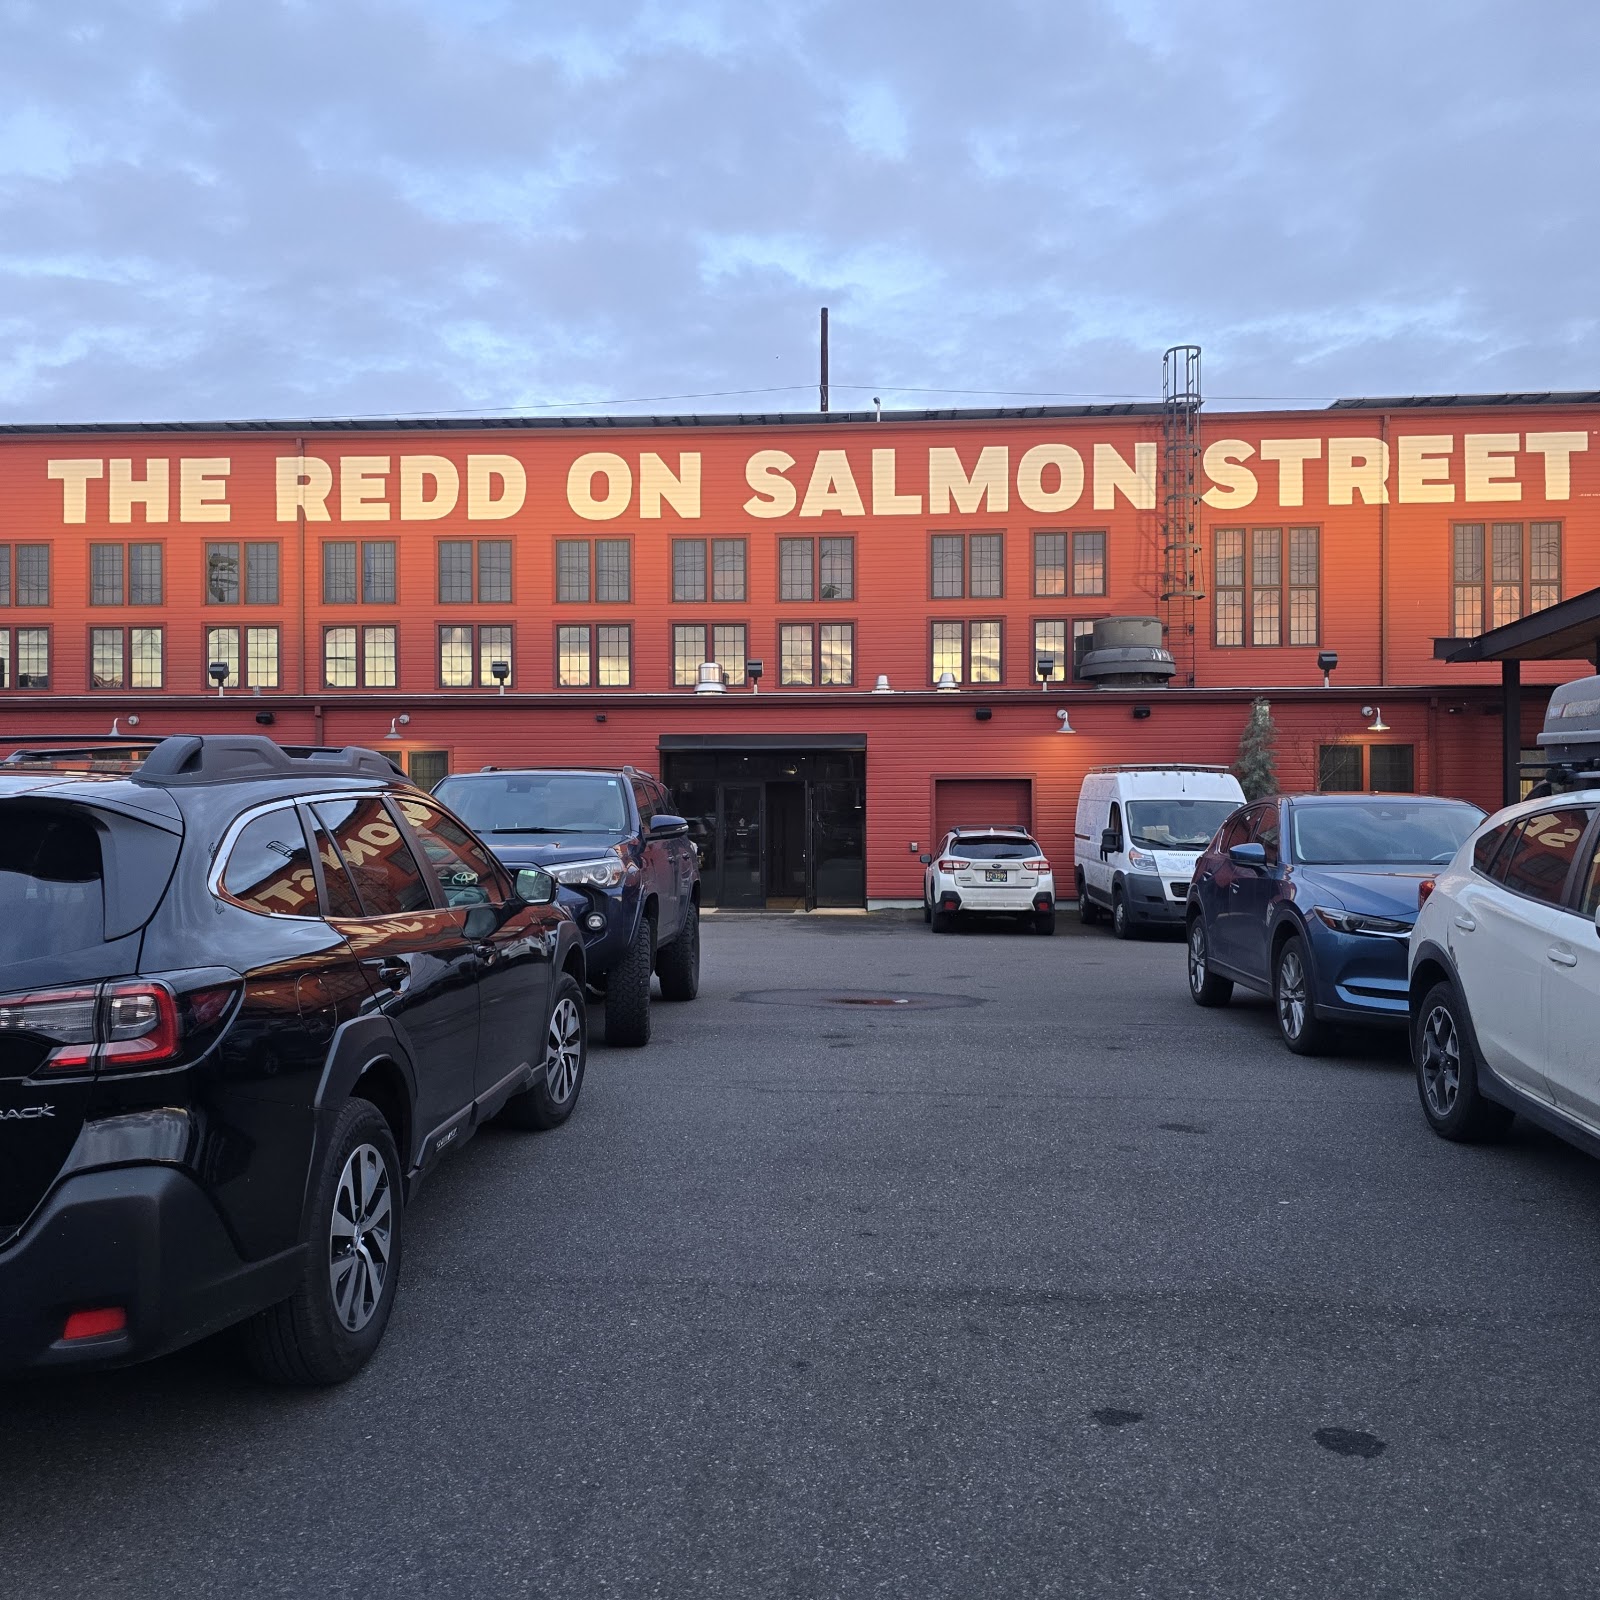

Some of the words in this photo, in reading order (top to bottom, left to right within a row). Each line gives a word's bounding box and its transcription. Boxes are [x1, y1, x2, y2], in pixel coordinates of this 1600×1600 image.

[47, 456, 231, 525] THE
[275, 453, 527, 522] REDD
[566, 451, 703, 520] ON
[742, 442, 1158, 519] SALMON
[1200, 430, 1589, 511] STREET
[0, 1102, 56, 1120] ACK
